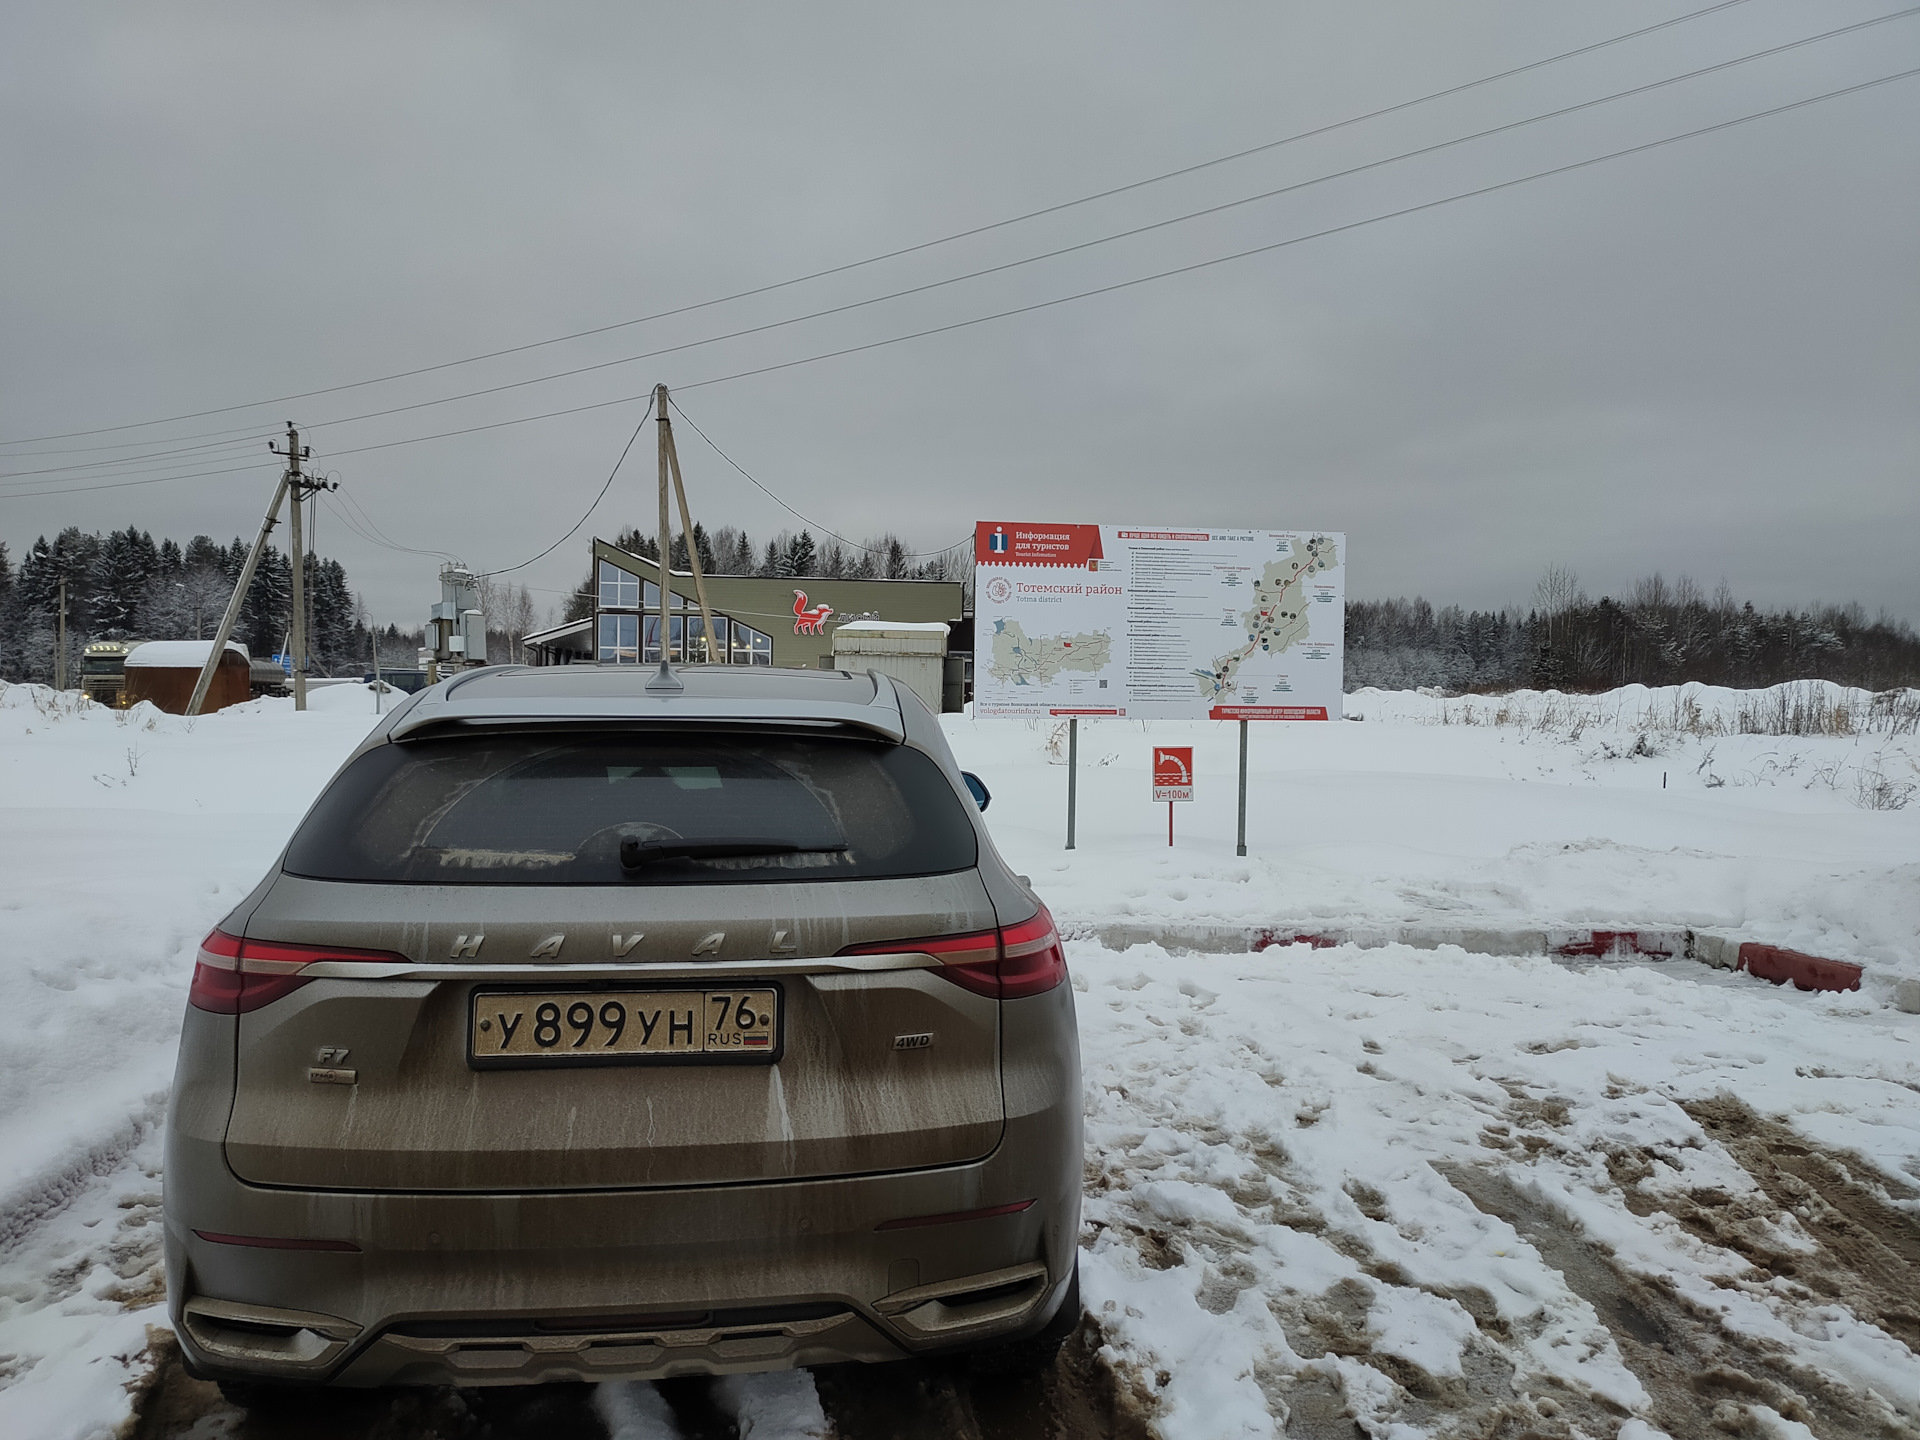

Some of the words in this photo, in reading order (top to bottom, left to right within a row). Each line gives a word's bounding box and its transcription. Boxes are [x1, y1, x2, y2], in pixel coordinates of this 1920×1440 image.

[1015, 531, 1070, 541] Информация
[1031, 543, 1069, 551] туристов
[1016, 583, 1082, 594] Тотемский
[1085, 584, 1122, 596] район
[980, 707, 1040, 715] vologdatourinfo.ru
[449, 930, 797, 958] HAVAL
[711, 996, 756, 1030] 76
[708, 1033, 741, 1045] RUS
[896, 1035, 929, 1048] 4WD
[317, 1047, 350, 1064] F7
